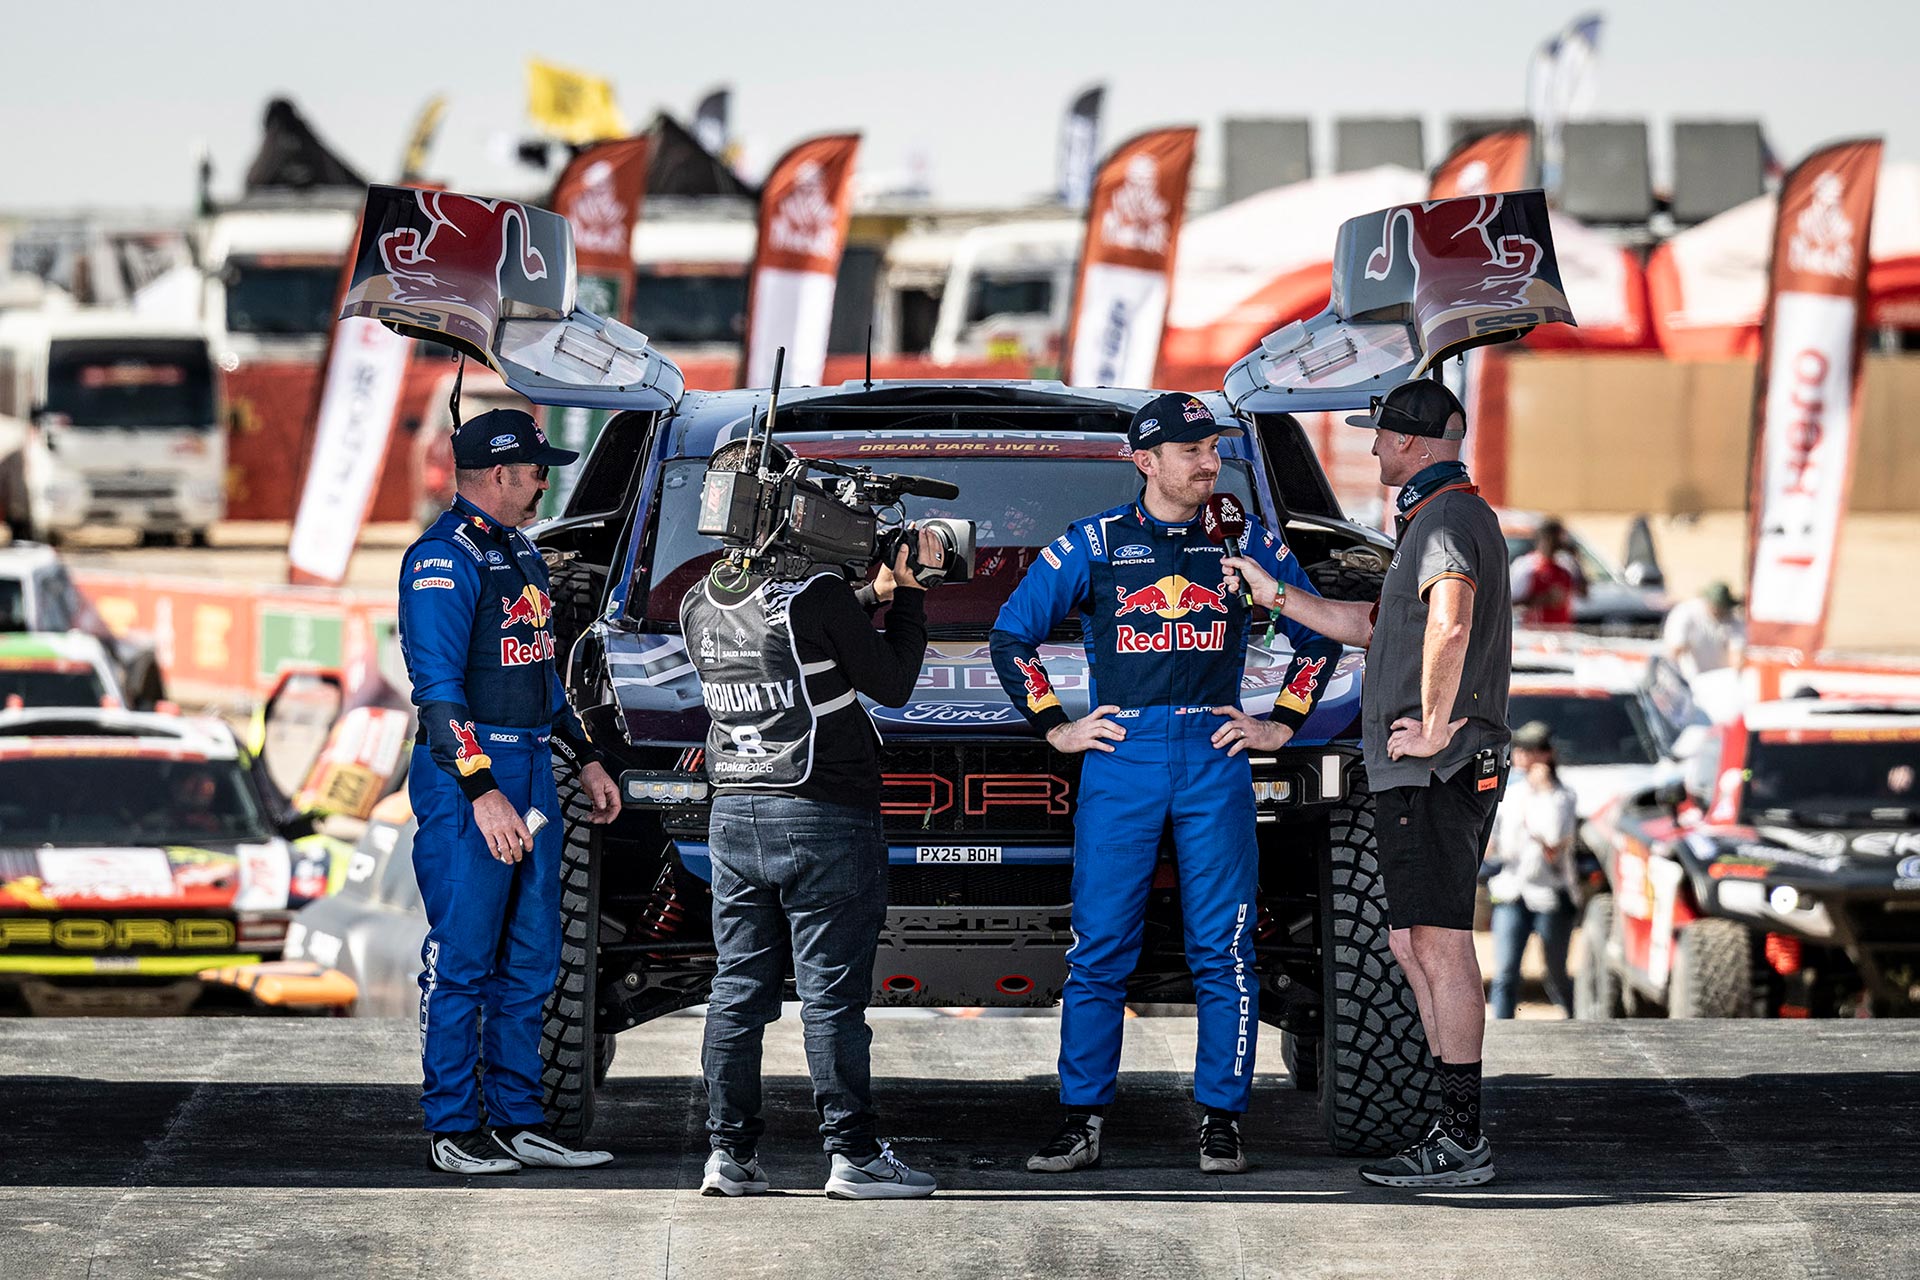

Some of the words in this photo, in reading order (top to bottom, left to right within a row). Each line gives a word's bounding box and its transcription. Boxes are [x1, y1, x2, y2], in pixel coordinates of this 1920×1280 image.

[491, 442, 519, 453] RACING
[858, 443, 930, 452] DREAM.
[935, 443, 990, 451] DARE.
[994, 443, 1036, 451] LIVE
[1084, 523, 1102, 556] sparco
[422, 558, 453, 569] OPTIMA
[1112, 557, 1155, 567] RACING
[421, 579, 453, 588] Castrol
[1116, 622, 1172, 653] Red
[1176, 620, 1226, 651] Bull
[501, 631, 543, 666] Red
[761, 680, 795, 710] TV
[904, 703, 1011, 722] Ford
[490, 733, 520, 743] sparco
[731, 725, 767, 757] 8
[551, 736, 576, 760] sparco
[715, 761, 774, 773] #Dakar2026
[919, 848, 962, 862] PX25
[966, 848, 998, 862] BOH
[1234, 995, 1250, 1077] FORD
